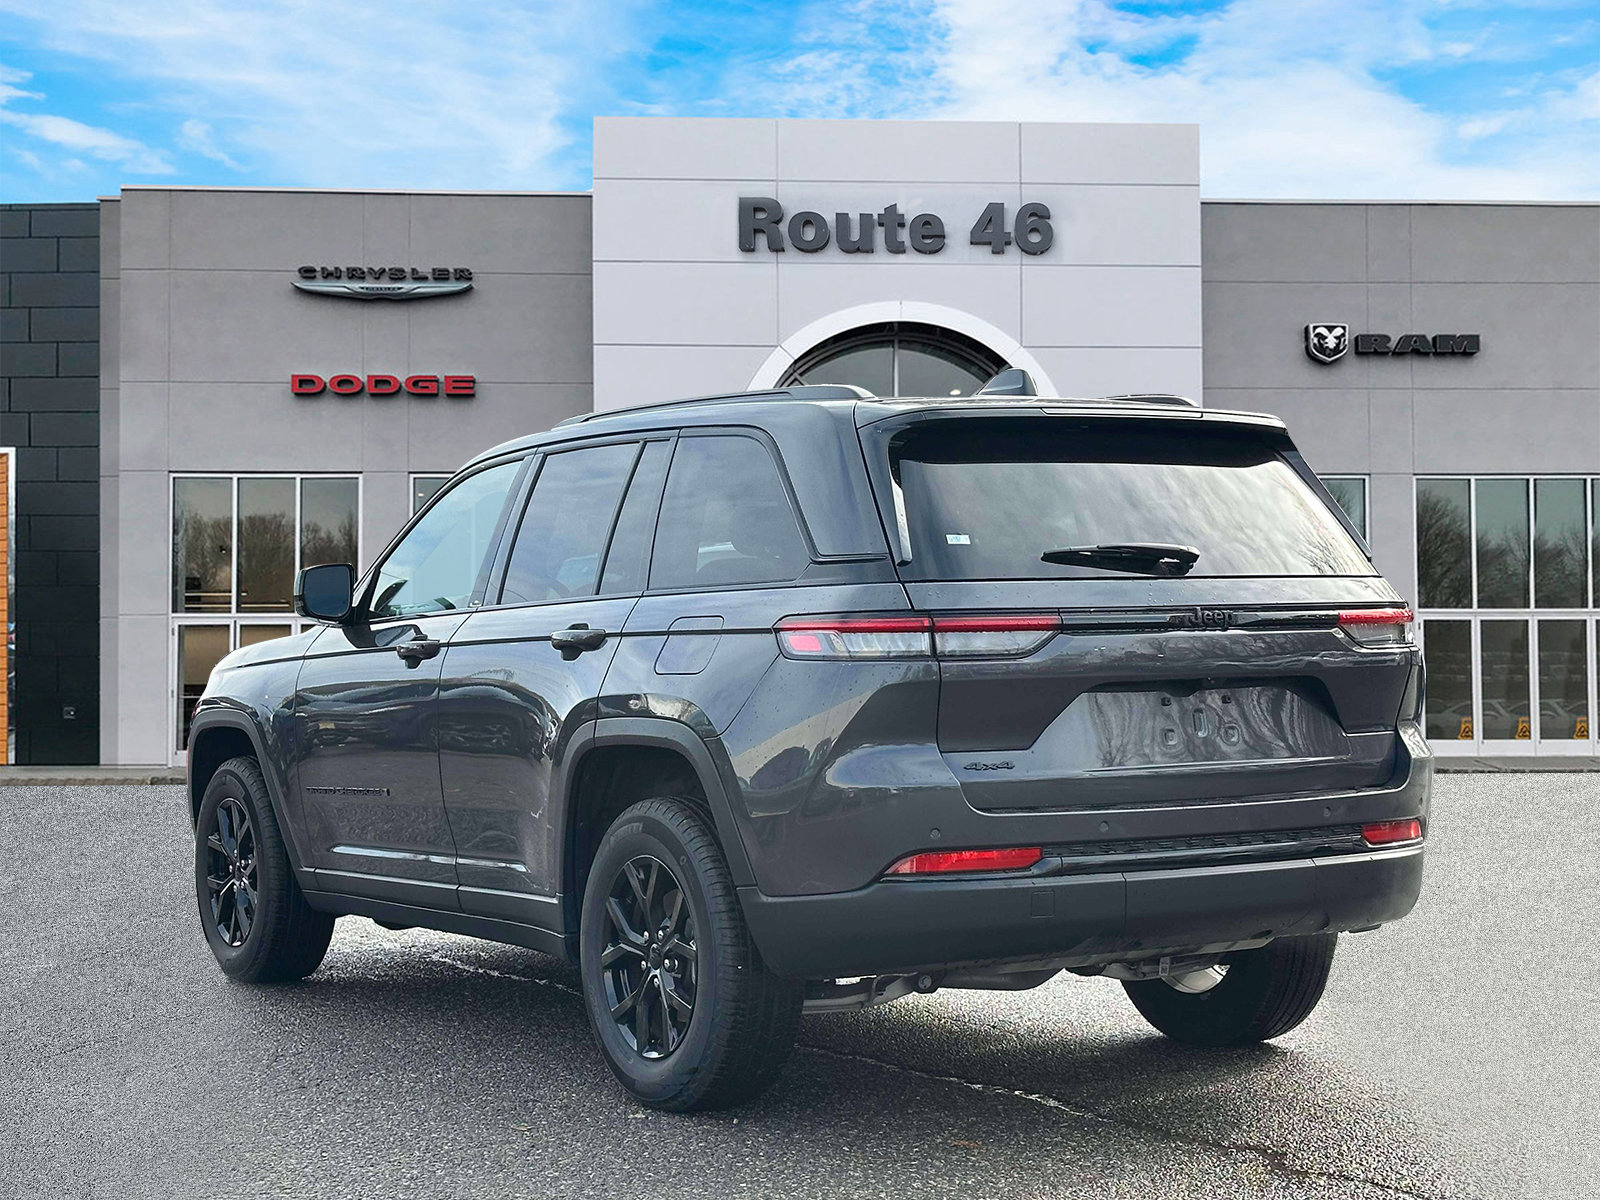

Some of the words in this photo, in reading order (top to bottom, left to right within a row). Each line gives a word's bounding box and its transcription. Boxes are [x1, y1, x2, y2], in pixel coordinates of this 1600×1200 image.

[738, 197, 946, 255] Route
[969, 202, 1054, 256] 46
[298, 266, 473, 281] CHRYSLER
[1355, 334, 1480, 356] RAM
[291, 374, 476, 397] DODGE
[1190, 606, 1235, 628] Jeep
[963, 760, 1016, 771] 4x4
